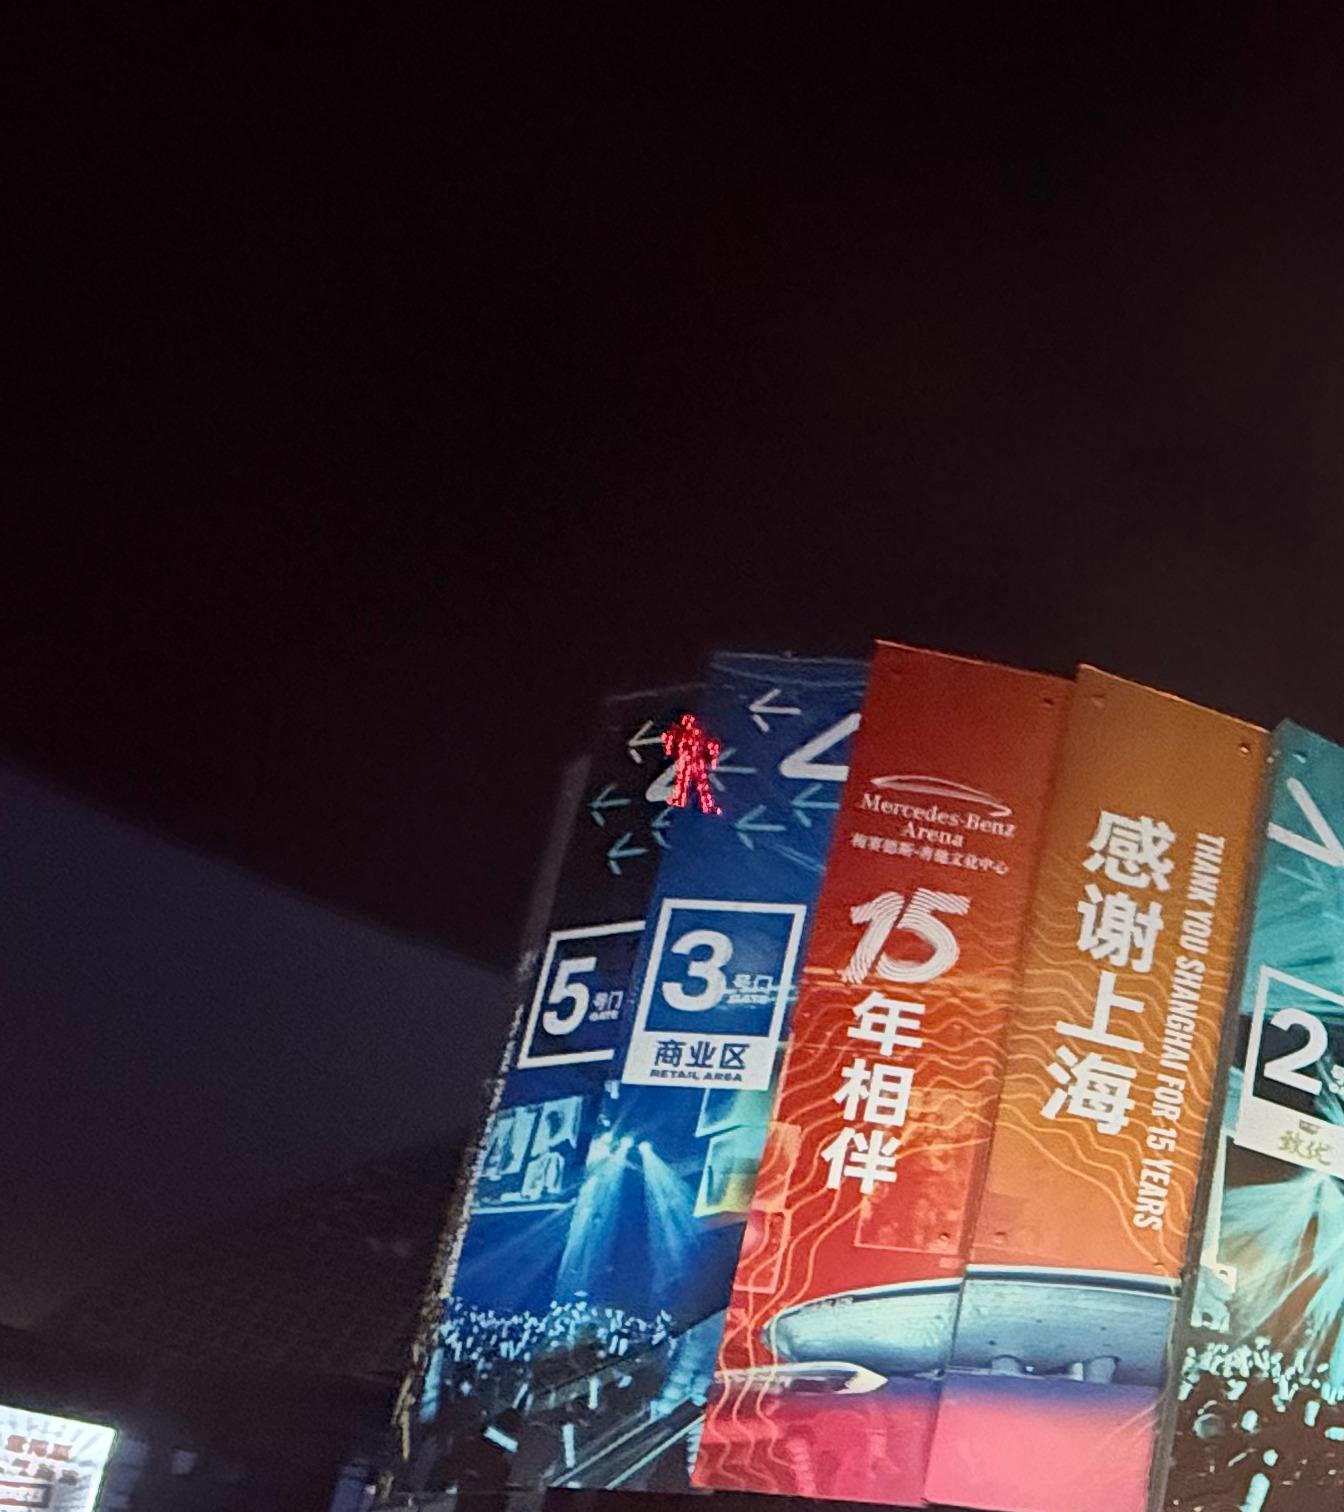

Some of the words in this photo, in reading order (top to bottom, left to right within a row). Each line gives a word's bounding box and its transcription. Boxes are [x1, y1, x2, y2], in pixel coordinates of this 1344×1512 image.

[861, 793, 1017, 838] Mercedes-Benz
[901, 821, 965, 848] Arena
[1187, 832, 1225, 903] THANK
[1179, 906, 1213, 954] YOU
[543, 956, 597, 1036] 5
[662, 929, 733, 1011] 3
[1040, 809, 1177, 1137] 感谢上海
[1159, 955, 1204, 1070] SHANGHAI
[650, 1069, 700, 1081] RETAIL
[702, 1071, 743, 1083] AREA
[655, 1039, 750, 1070] 商业区
[1264, 1008, 1328, 1095] 2
[1151, 1074, 1184, 1121] FOR
[1147, 1125, 1179, 1152] 15
[1133, 1157, 1175, 1231] YEARS
